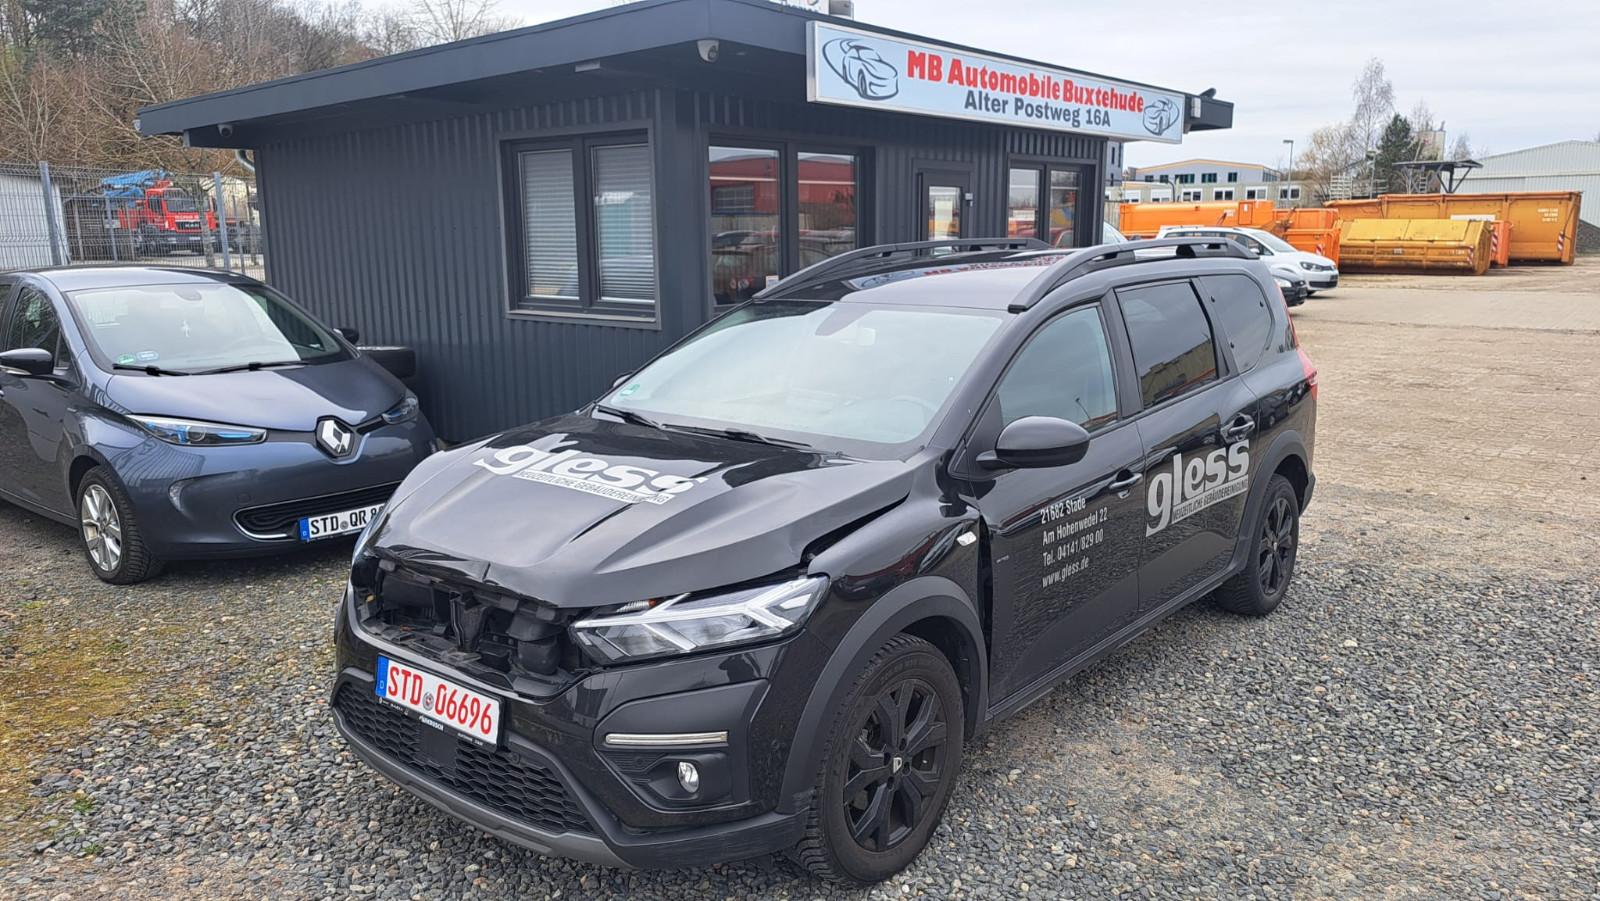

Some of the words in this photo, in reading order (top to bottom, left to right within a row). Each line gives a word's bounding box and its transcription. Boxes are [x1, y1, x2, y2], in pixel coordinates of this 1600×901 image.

[907, 50, 942, 82] MB
[948, 58, 1060, 100] Automobile
[1063, 79, 1144, 112] Buxtehude
[964, 90, 1008, 114] Alter
[1014, 97, 1080, 128] Postweg
[1085, 109, 1111, 127] 16A
[473, 445, 708, 495] gless
[1146, 439, 1249, 537] gless
[311, 516, 339, 535] STD
[350, 510, 367, 527] QR
[1040, 503, 1064, 524] 21682
[1066, 496, 1086, 514] Stade
[1043, 531, 1054, 546] Am
[1057, 510, 1098, 539] Hohenwedel
[1100, 507, 1108, 522] 22
[1043, 549, 1055, 566] Tel.
[1043, 555, 1089, 588] www.gless.de
[388, 666, 423, 705] STD
[435, 683, 492, 734] 06696
